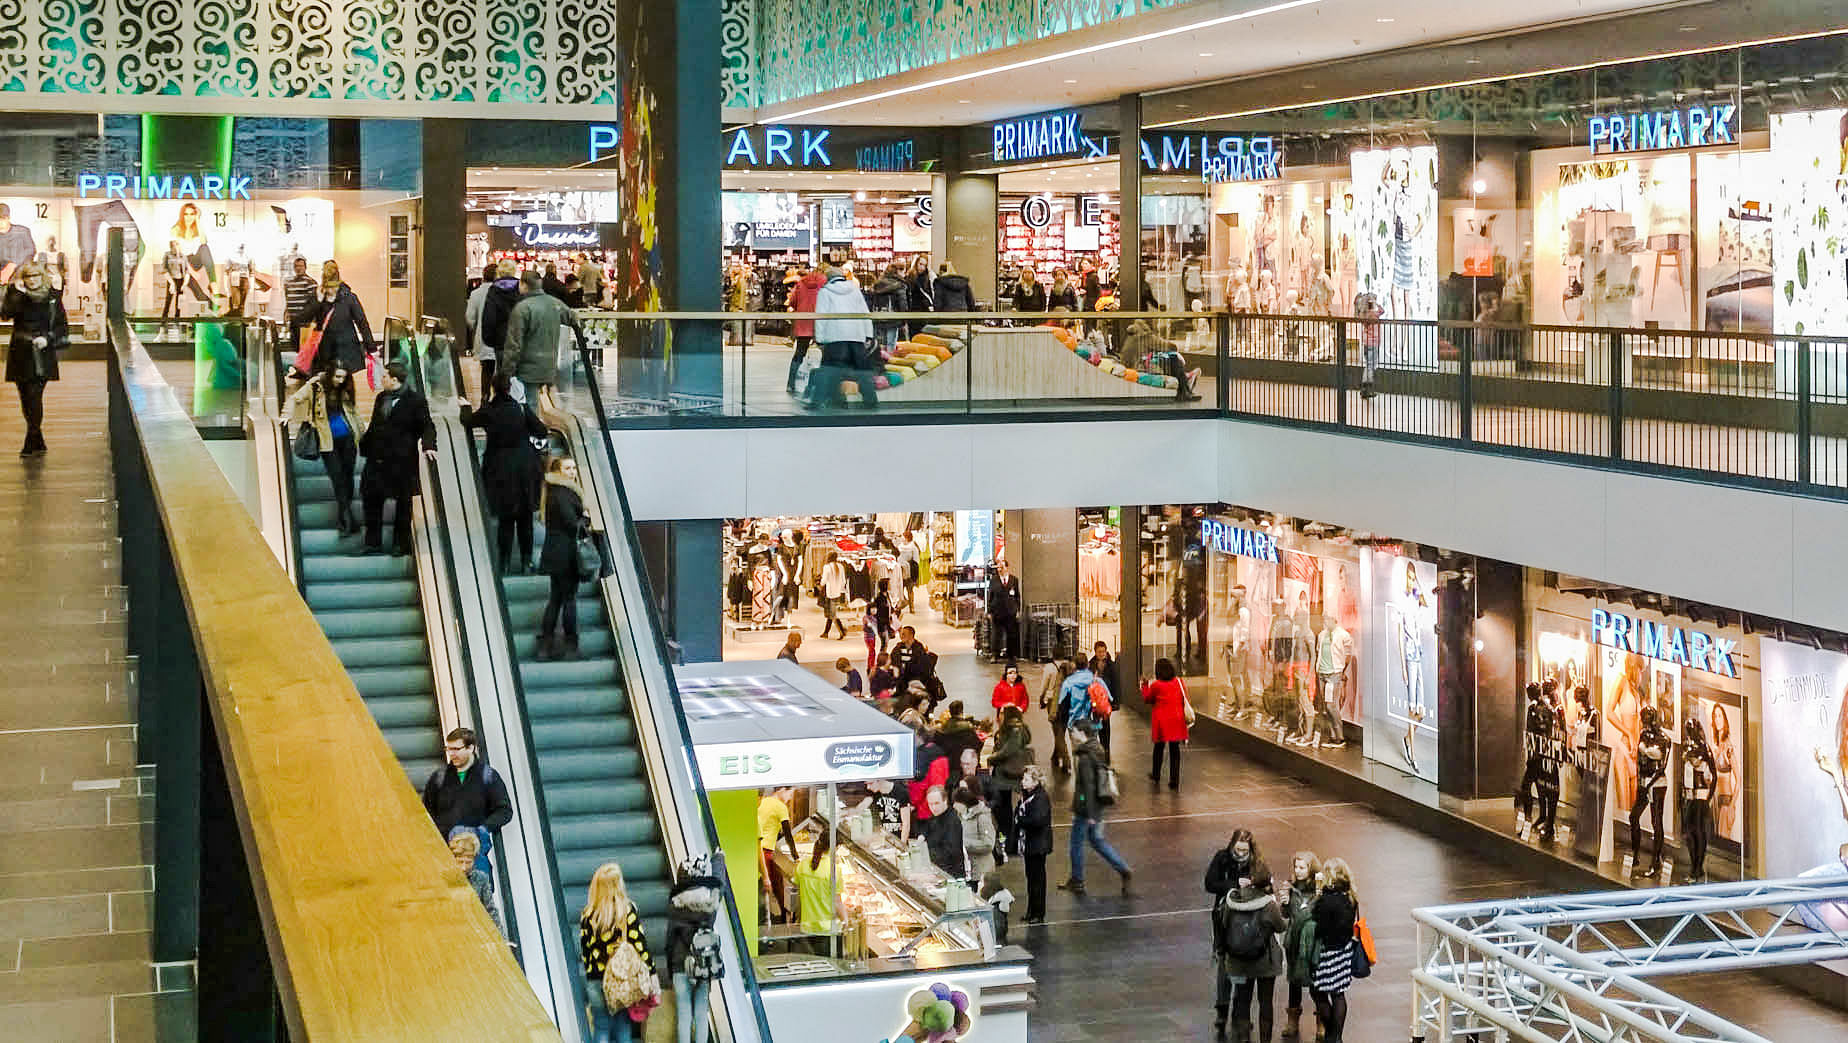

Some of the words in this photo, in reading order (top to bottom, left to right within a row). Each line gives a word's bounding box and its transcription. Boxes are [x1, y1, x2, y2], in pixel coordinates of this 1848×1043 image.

[589, 125, 831, 165] PARK
[993, 112, 1079, 161] PRIMARK
[1589, 104, 1735, 154] PRIMARK
[79, 174, 252, 200] PRIMARK
[1202, 150, 1281, 184] PRIMARK
[1201, 519, 1280, 564] PRIMARK
[1592, 608, 1737, 678] PRIMARK
